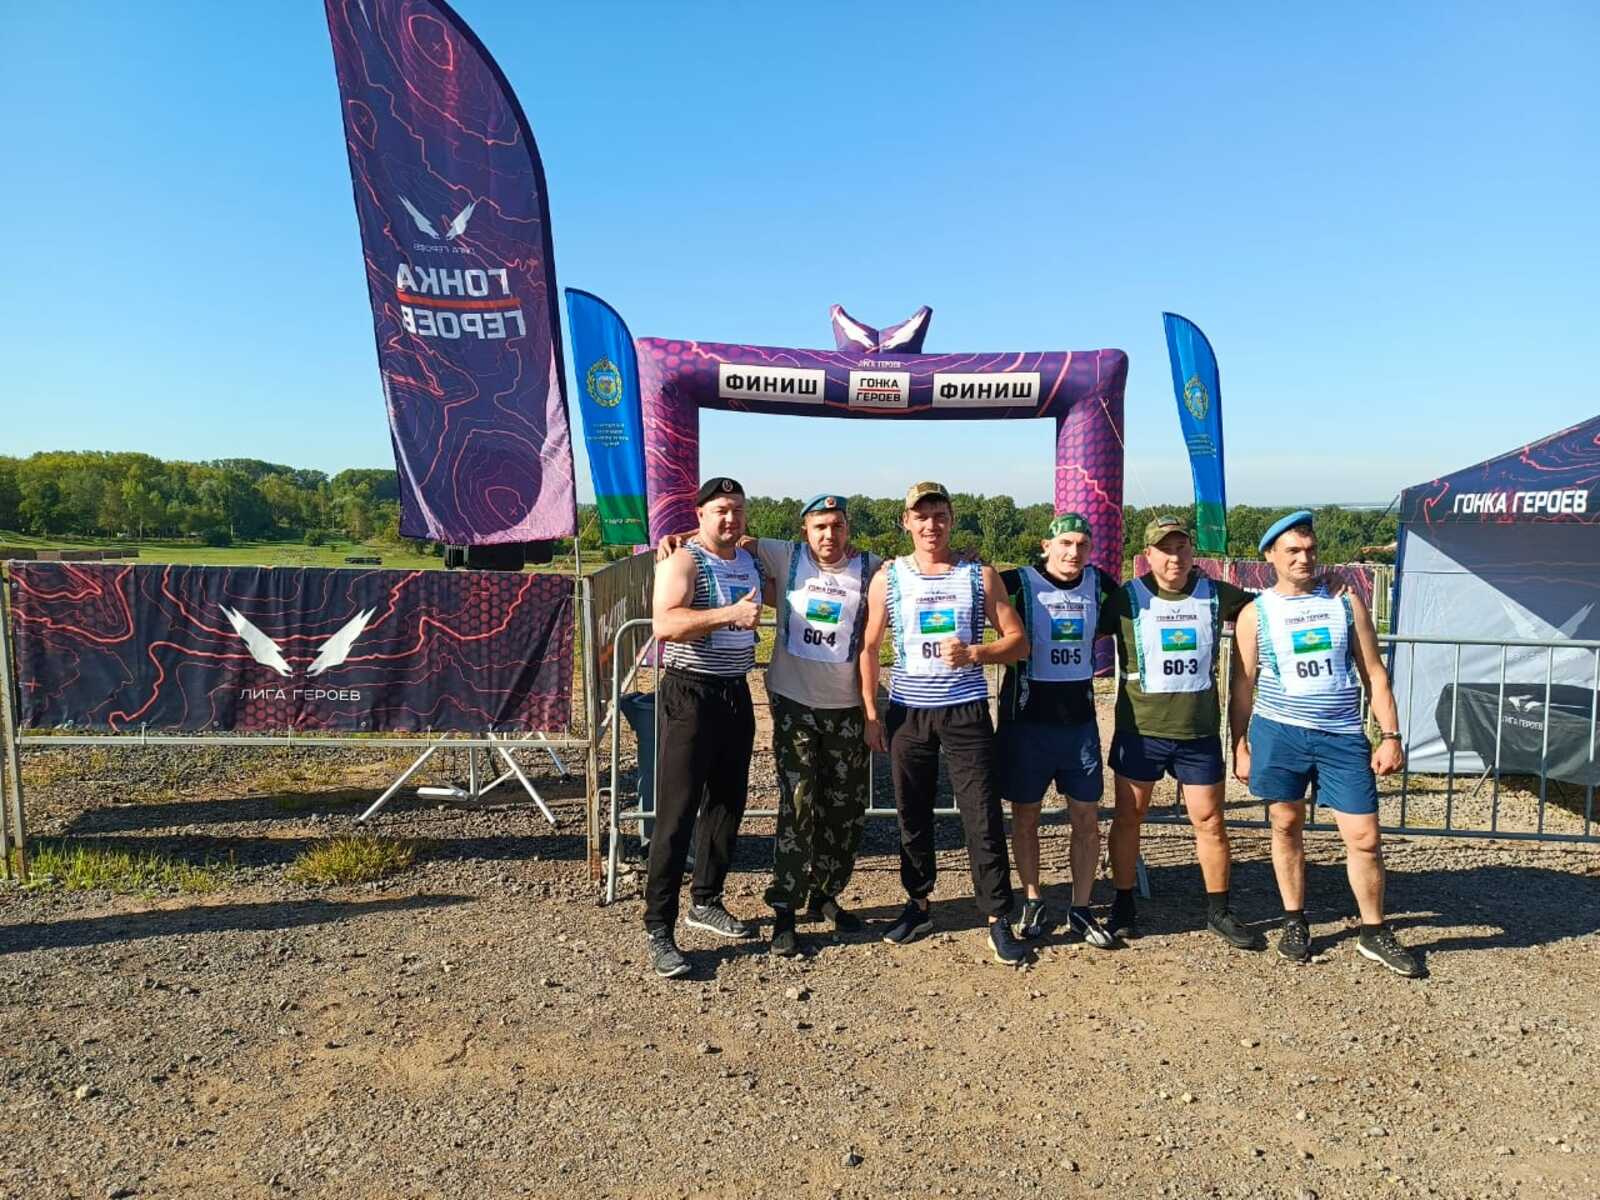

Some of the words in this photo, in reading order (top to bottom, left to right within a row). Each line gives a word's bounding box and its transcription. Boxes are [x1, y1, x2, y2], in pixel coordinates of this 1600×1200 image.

[725, 373, 818, 395] ФИНИШ
[859, 377, 899, 388] ГОНКА
[939, 382, 1033, 400] ФИНИШ
[856, 391, 901, 402] ГЕРОЕВ
[1453, 492, 1507, 514] ГОНКА
[1512, 489, 1589, 514] ГЕРОЕВ
[804, 628, 837, 647] 60-4
[922, 641, 942, 659] 60
[1051, 648, 1082, 665] 60-5
[1163, 658, 1198, 676] 60-3
[1296, 658, 1334, 678] 60-1
[240, 688, 286, 701] ЛИГА
[293, 689, 361, 701] ГЕРОЕВ
